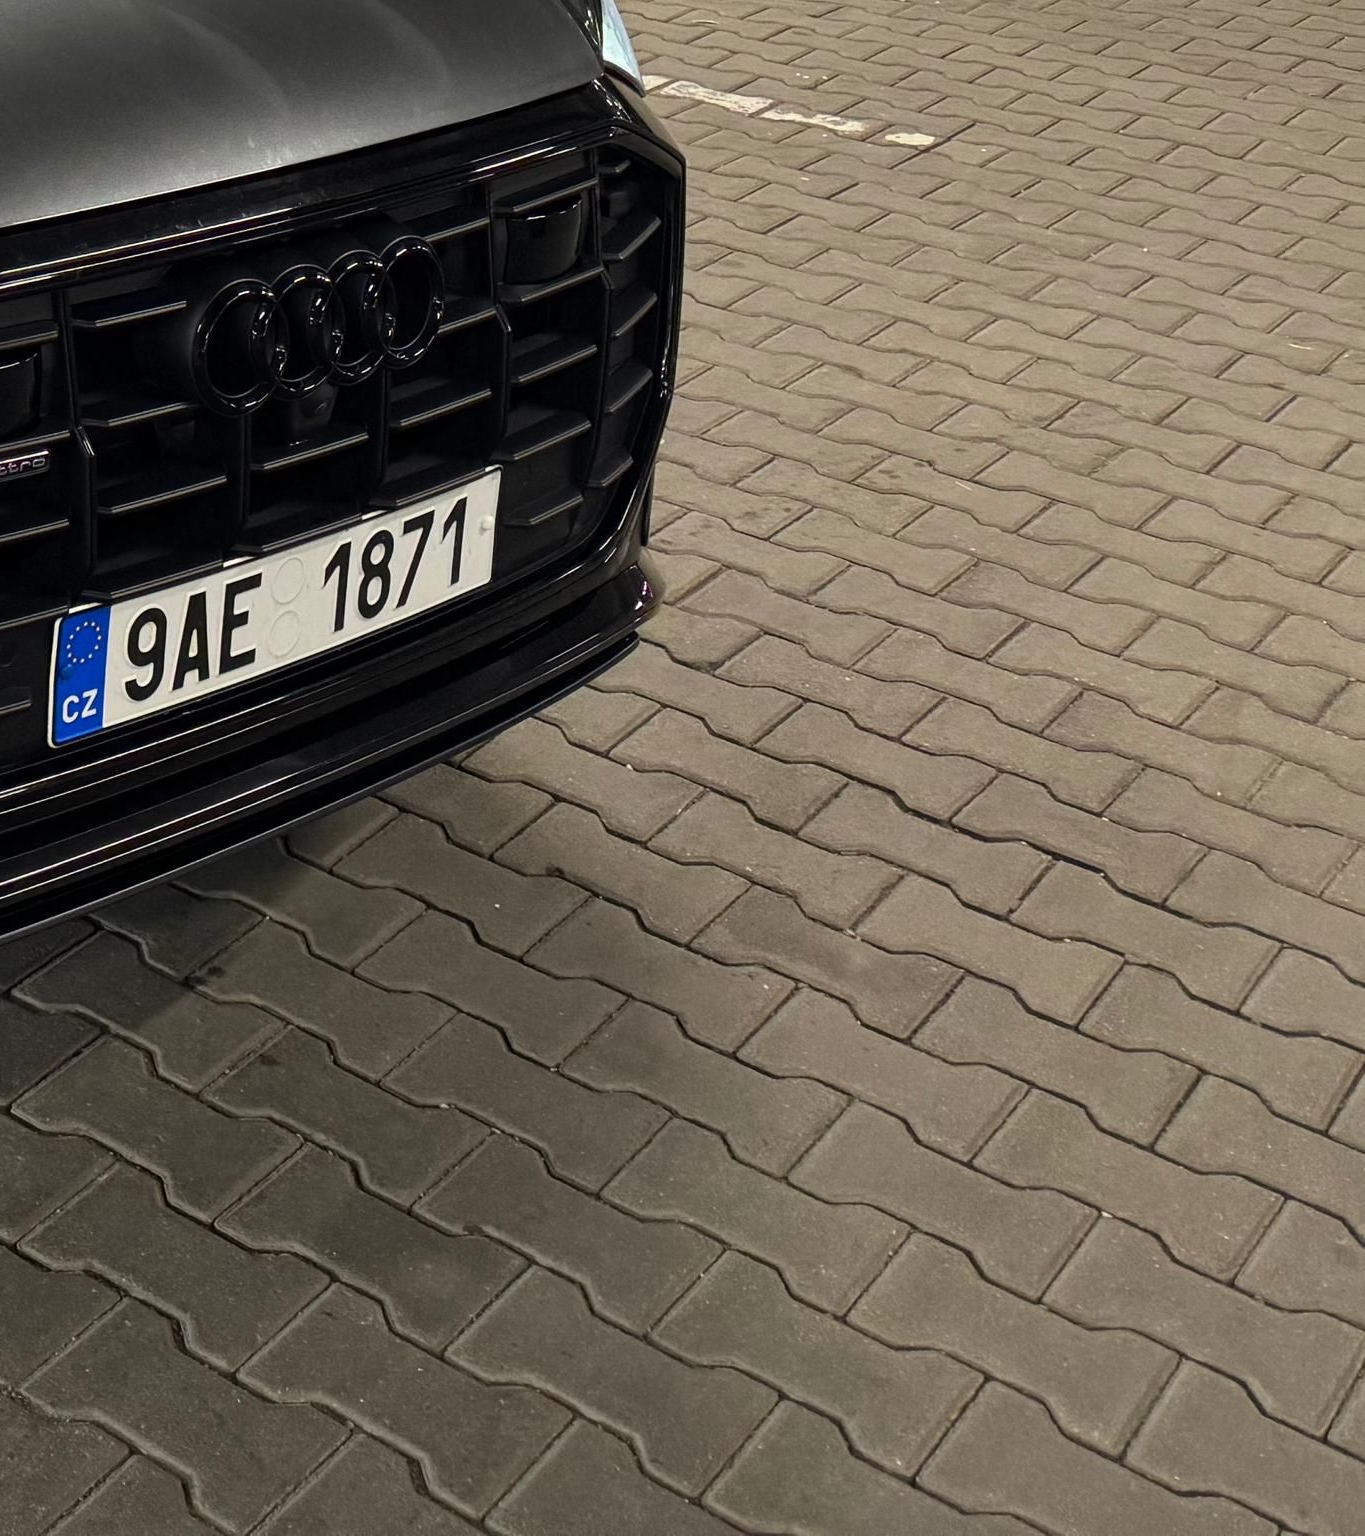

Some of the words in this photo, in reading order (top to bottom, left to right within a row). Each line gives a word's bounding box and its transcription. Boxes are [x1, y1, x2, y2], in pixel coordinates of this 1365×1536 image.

[125, 571, 262, 702] 9AE
[322, 494, 469, 633] 1871
[61, 688, 98, 725] CZ
